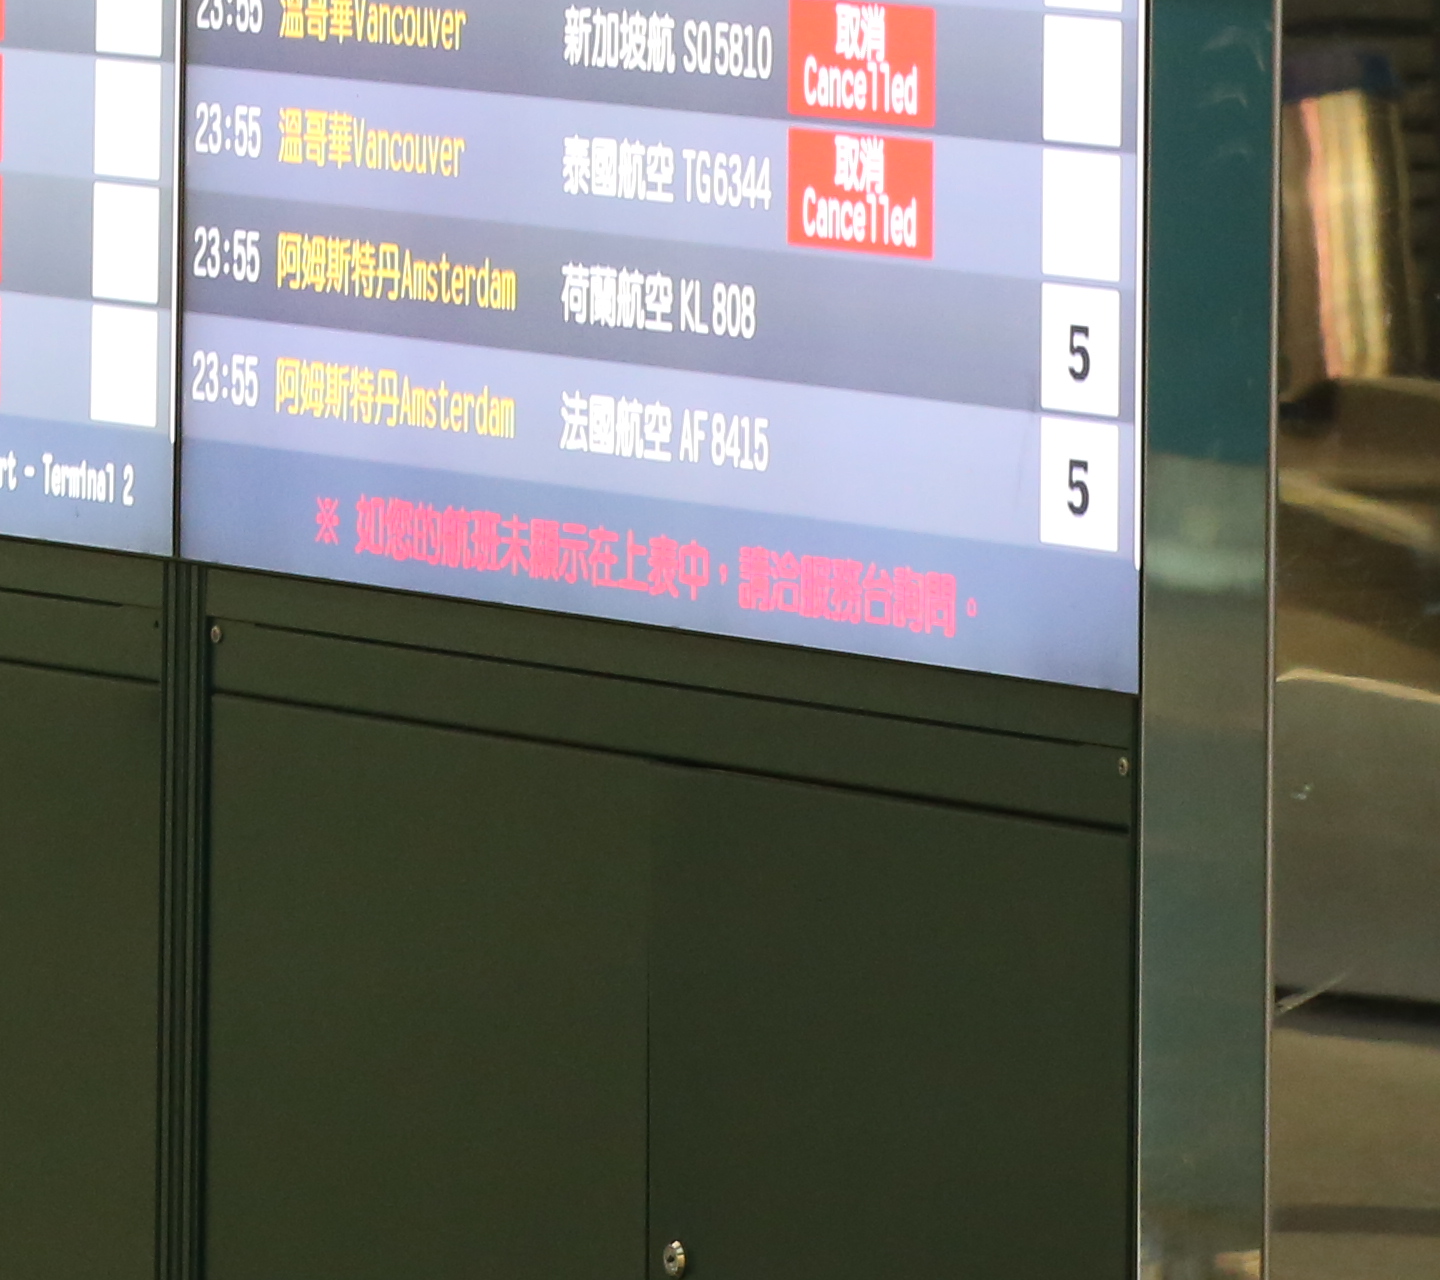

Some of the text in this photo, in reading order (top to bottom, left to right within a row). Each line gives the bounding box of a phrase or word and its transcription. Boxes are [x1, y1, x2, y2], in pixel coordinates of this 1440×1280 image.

[194, 226, 260, 282] 23:55
[561, 262, 673, 332] 荷蘭航空
[1069, 324, 1090, 382] 5
[42, 452, 114, 503] Terminal
[123, 463, 134, 506] 2
[192, 350, 259, 407] 23:55
[560, 391, 672, 462] 法國航空
[1068, 459, 1090, 516] 5
